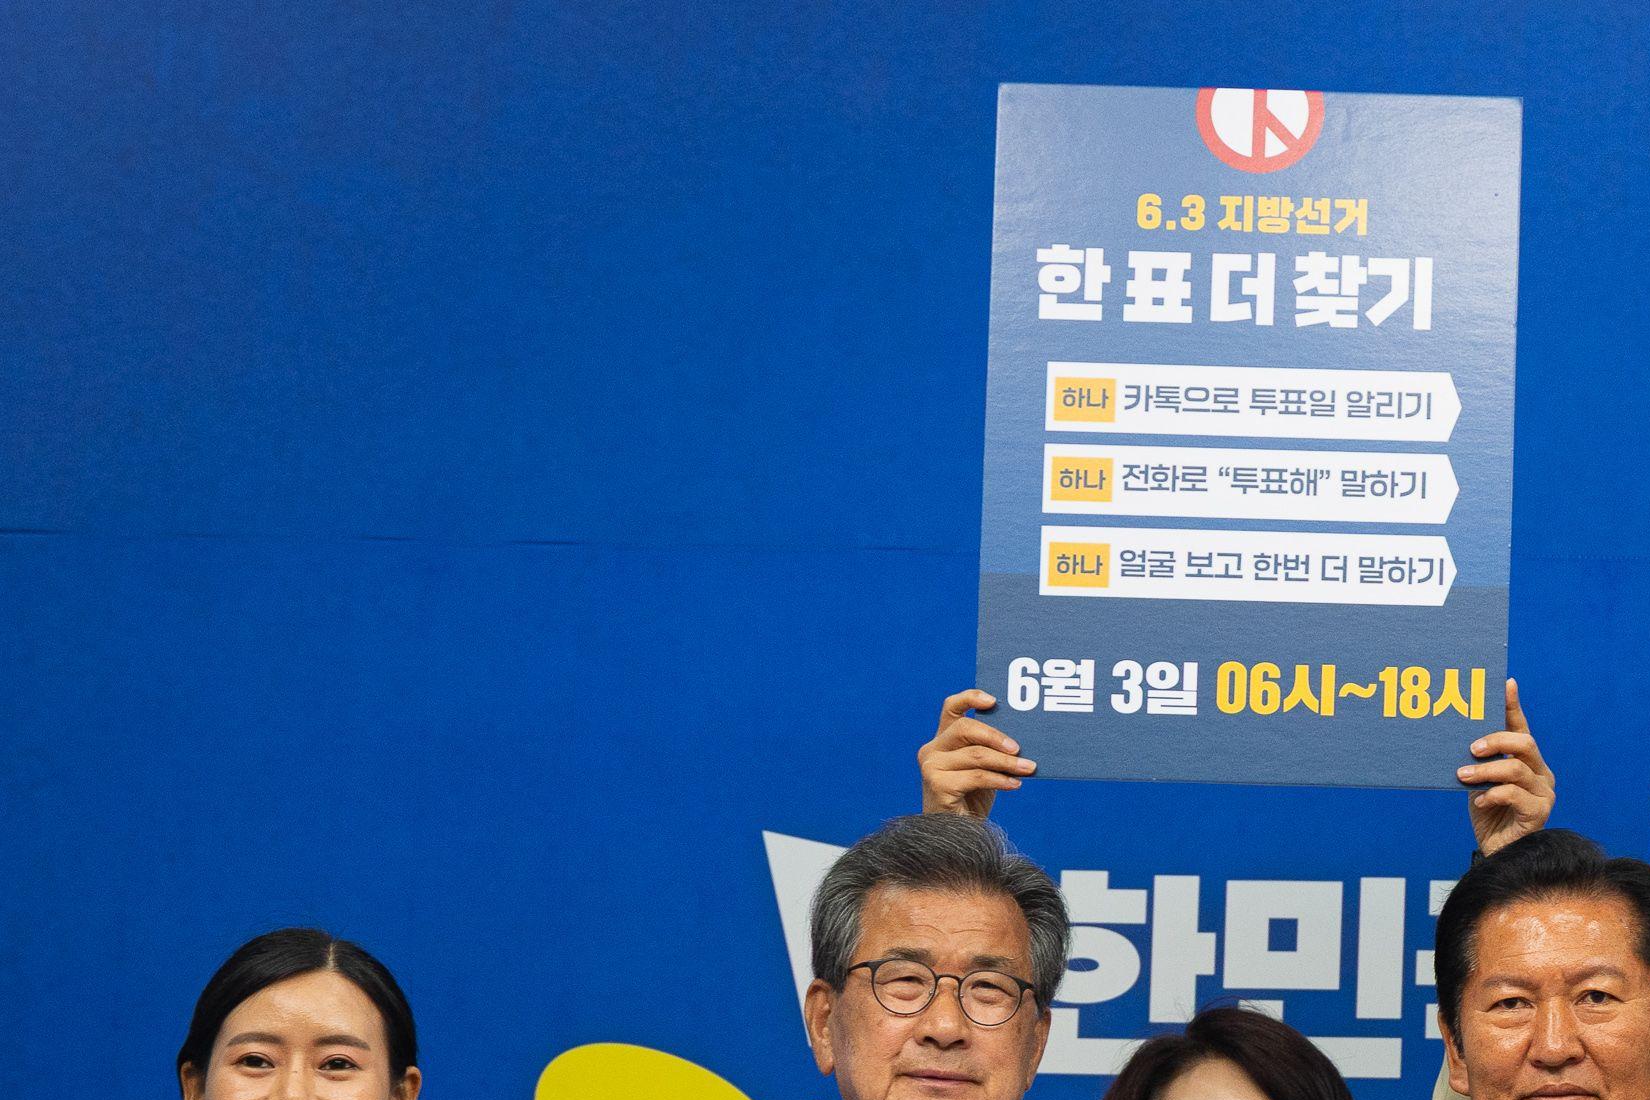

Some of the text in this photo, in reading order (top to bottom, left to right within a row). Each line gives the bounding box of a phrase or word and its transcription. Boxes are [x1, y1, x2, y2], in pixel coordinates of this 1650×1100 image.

[1137, 193, 1369, 236] 6.3 지방선거
[1036, 244, 1433, 331] 한 표 더 찾기
[1062, 384, 1432, 420] 하나 카톡으로 투표일 알리기
[1059, 468, 1106, 491] 하나
[1122, 463, 1208, 494] 전화로
[1341, 469, 1427, 499] 말하기
[1057, 549, 1445, 586] 하나 얼굴 보고 한번 더 말하기
[1007, 656, 1486, 720] 6월 3일 06시~18시
